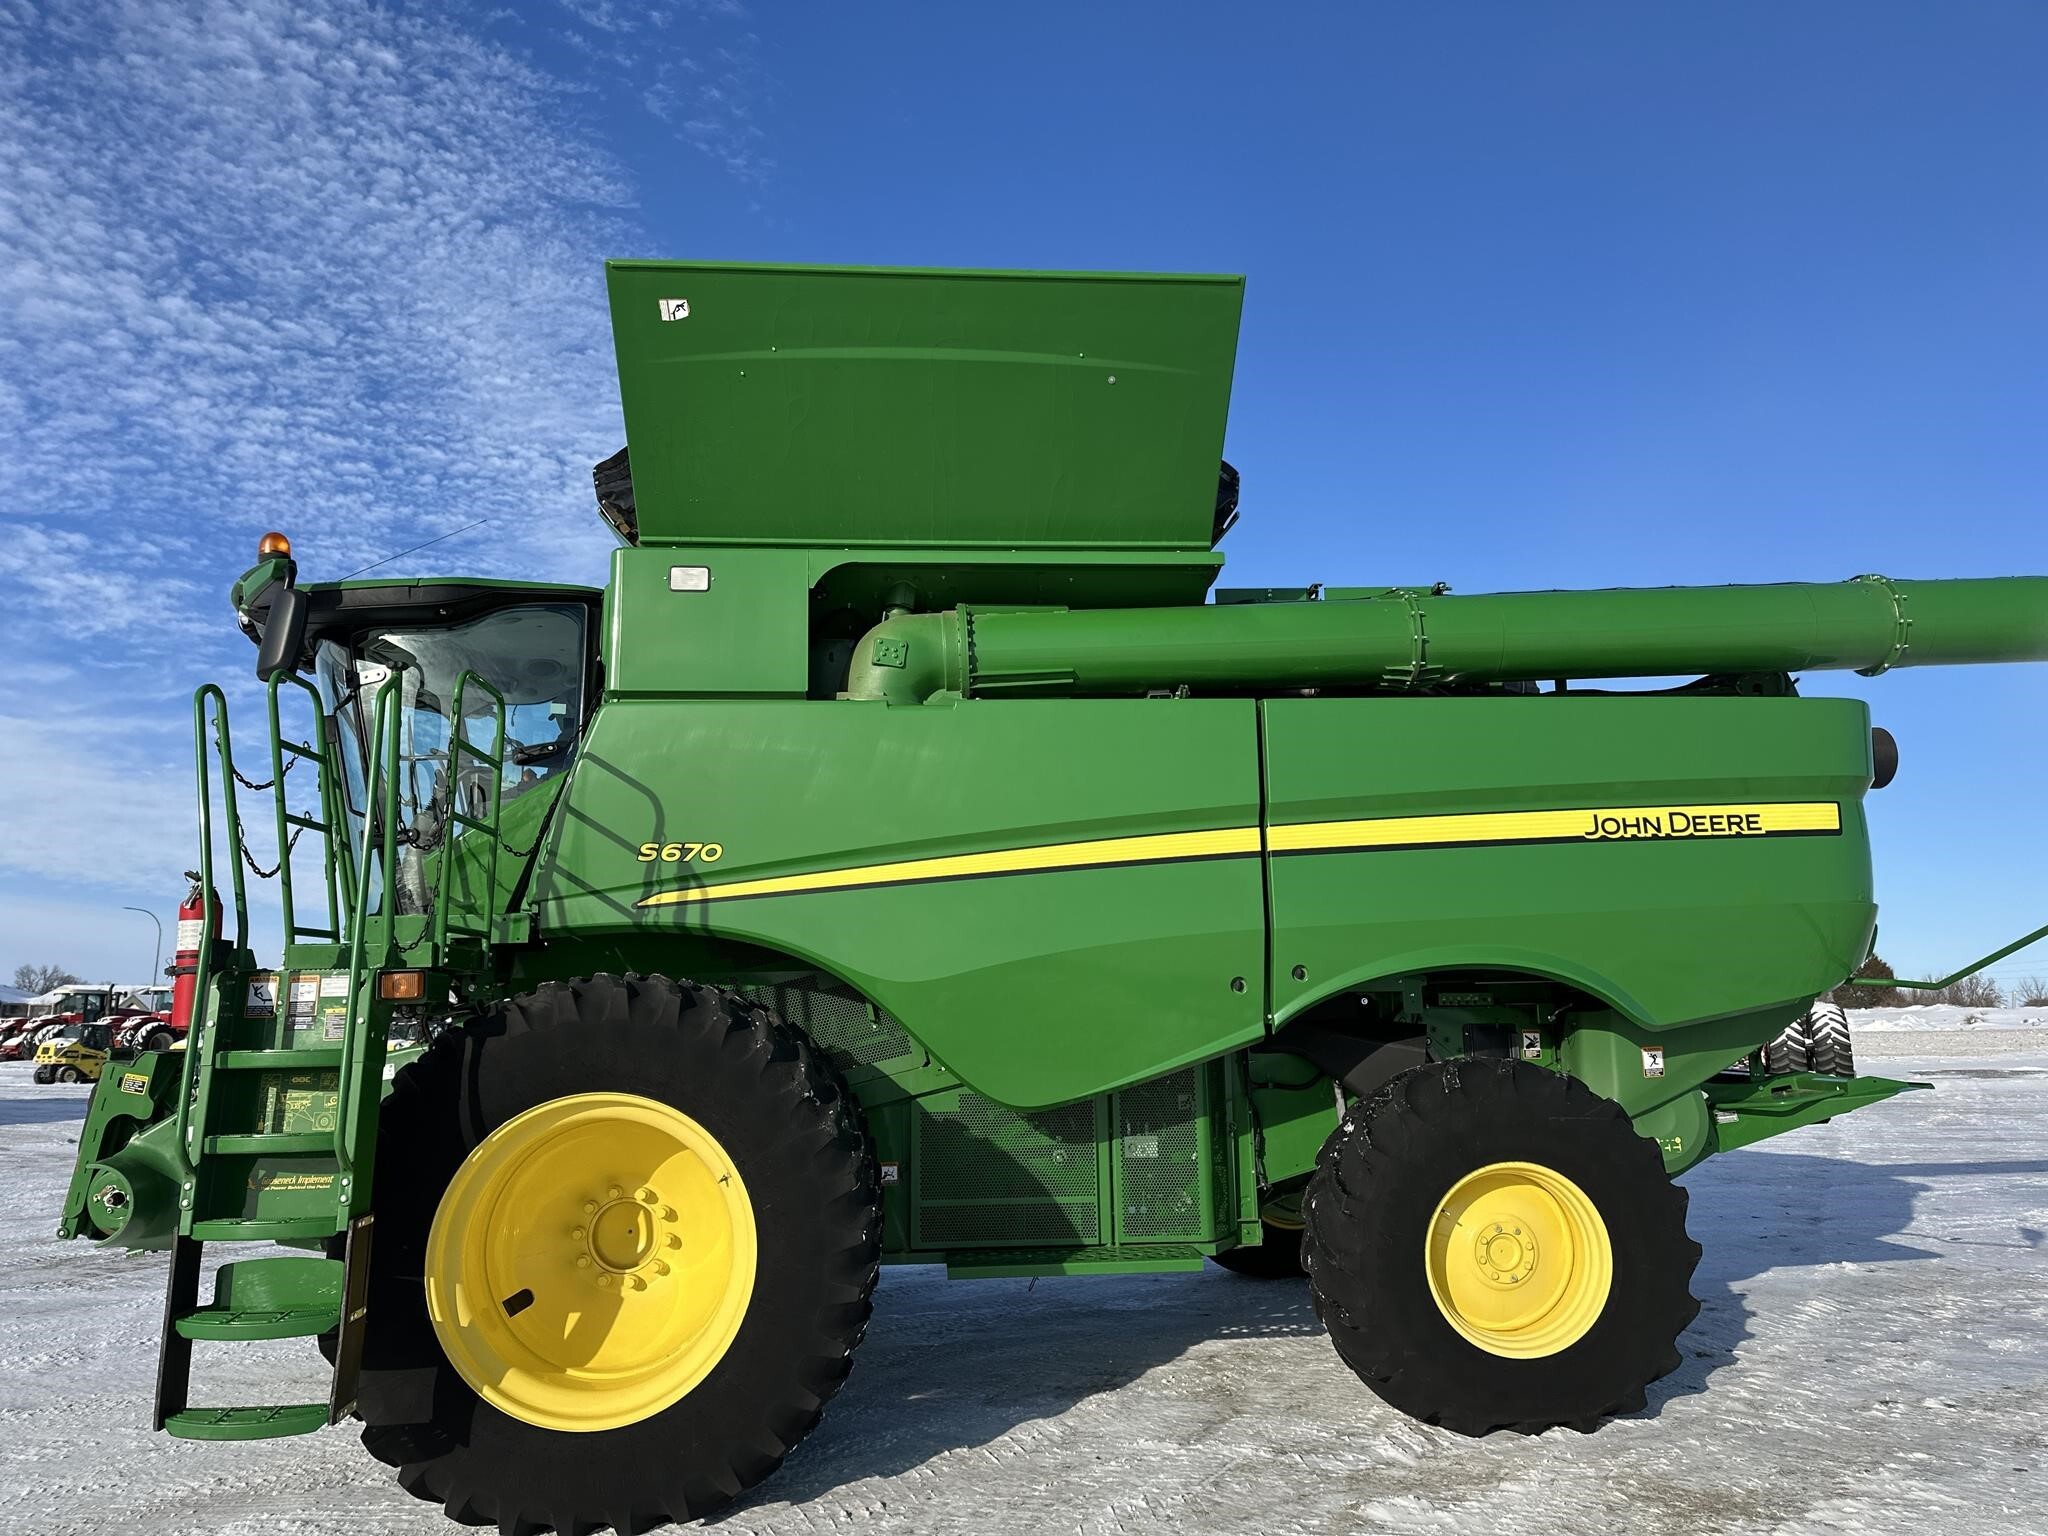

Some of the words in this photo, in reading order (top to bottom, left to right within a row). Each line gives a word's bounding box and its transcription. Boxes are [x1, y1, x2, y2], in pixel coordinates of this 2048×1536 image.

[1584, 813, 1662, 836] JOHN
[1668, 811, 1763, 834] DEERE
[637, 842, 723, 862] S670
[297, 1175, 334, 1186] Implement
